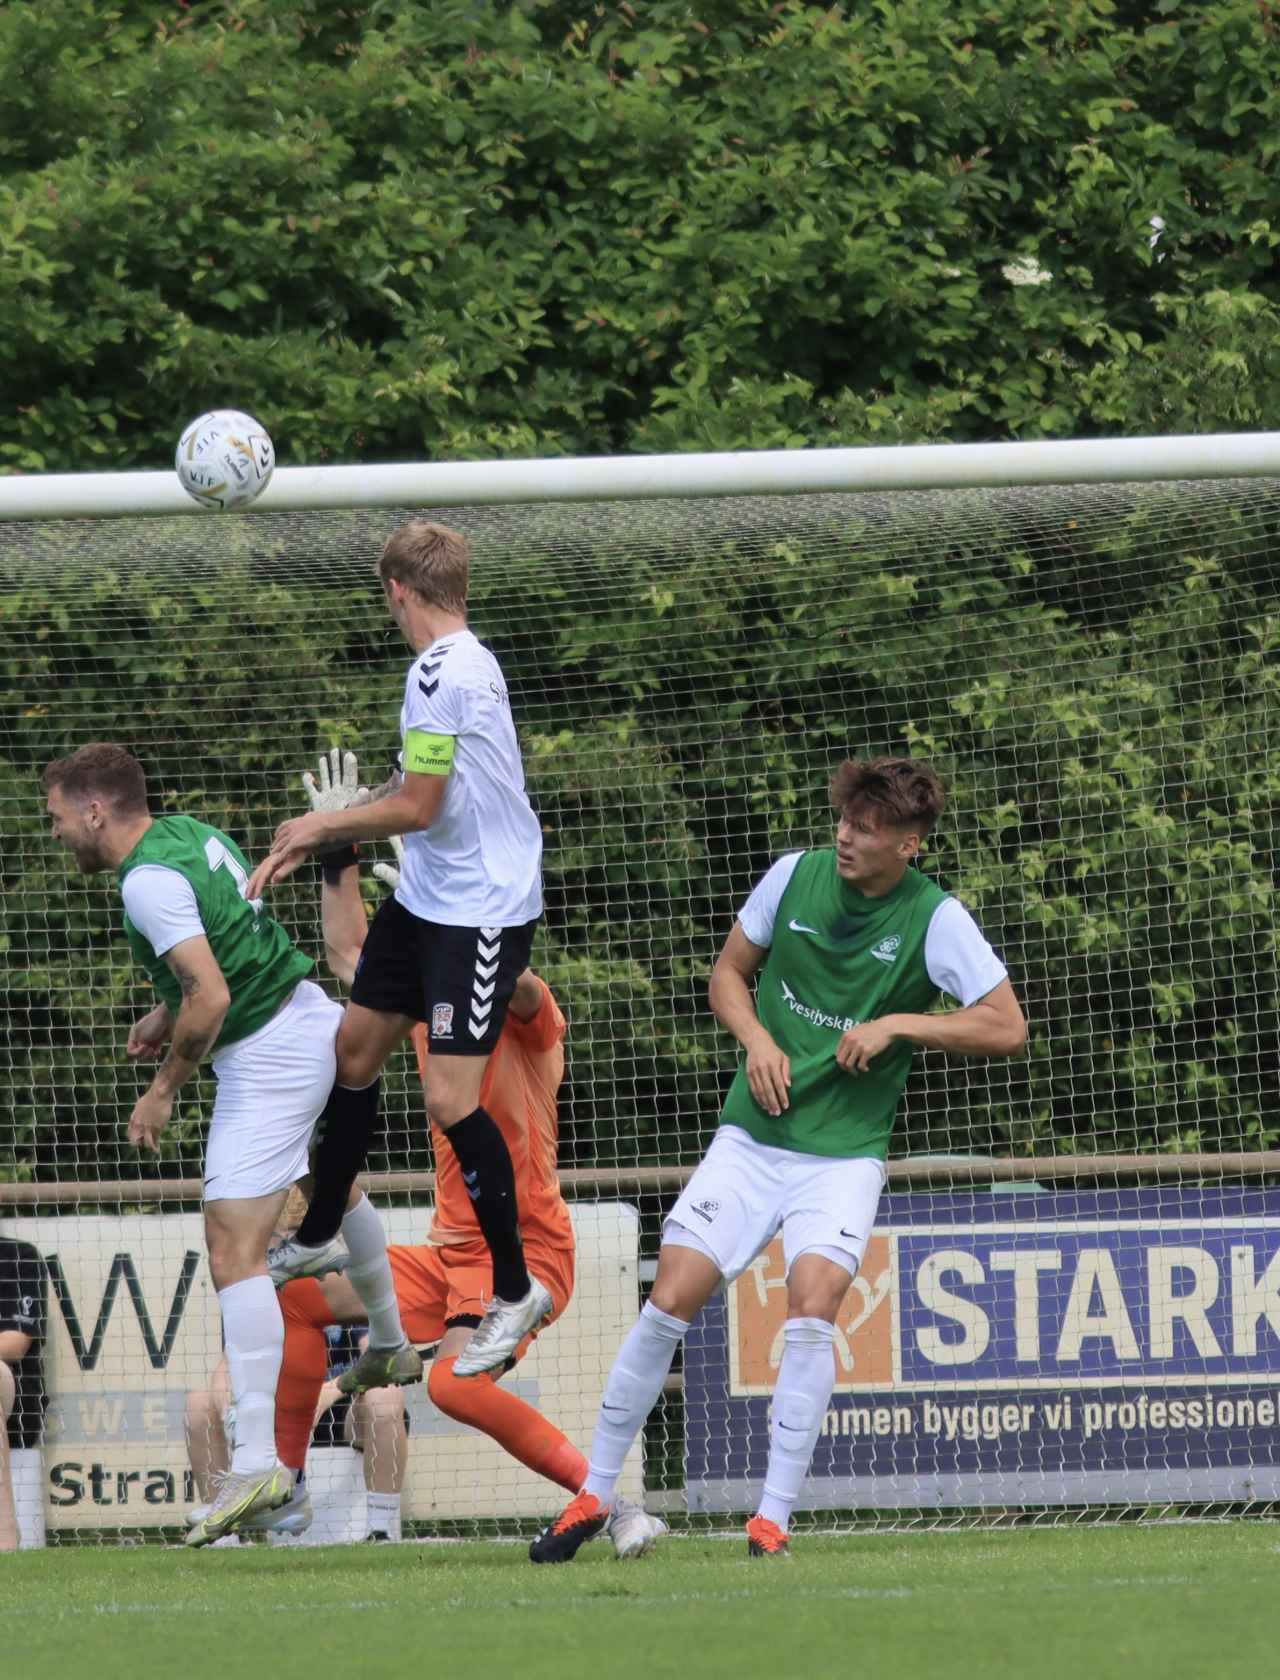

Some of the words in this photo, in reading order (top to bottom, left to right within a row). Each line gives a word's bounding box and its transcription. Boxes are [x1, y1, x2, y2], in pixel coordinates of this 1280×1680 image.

[414, 754, 451, 766] humme
[789, 998, 860, 1032] vestjyskB
[916, 1244, 1280, 1365] STARK
[924, 1400, 1035, 1440] bygger
[1045, 1396, 1070, 1430] vi
[50, 1463, 194, 1506] Stra
